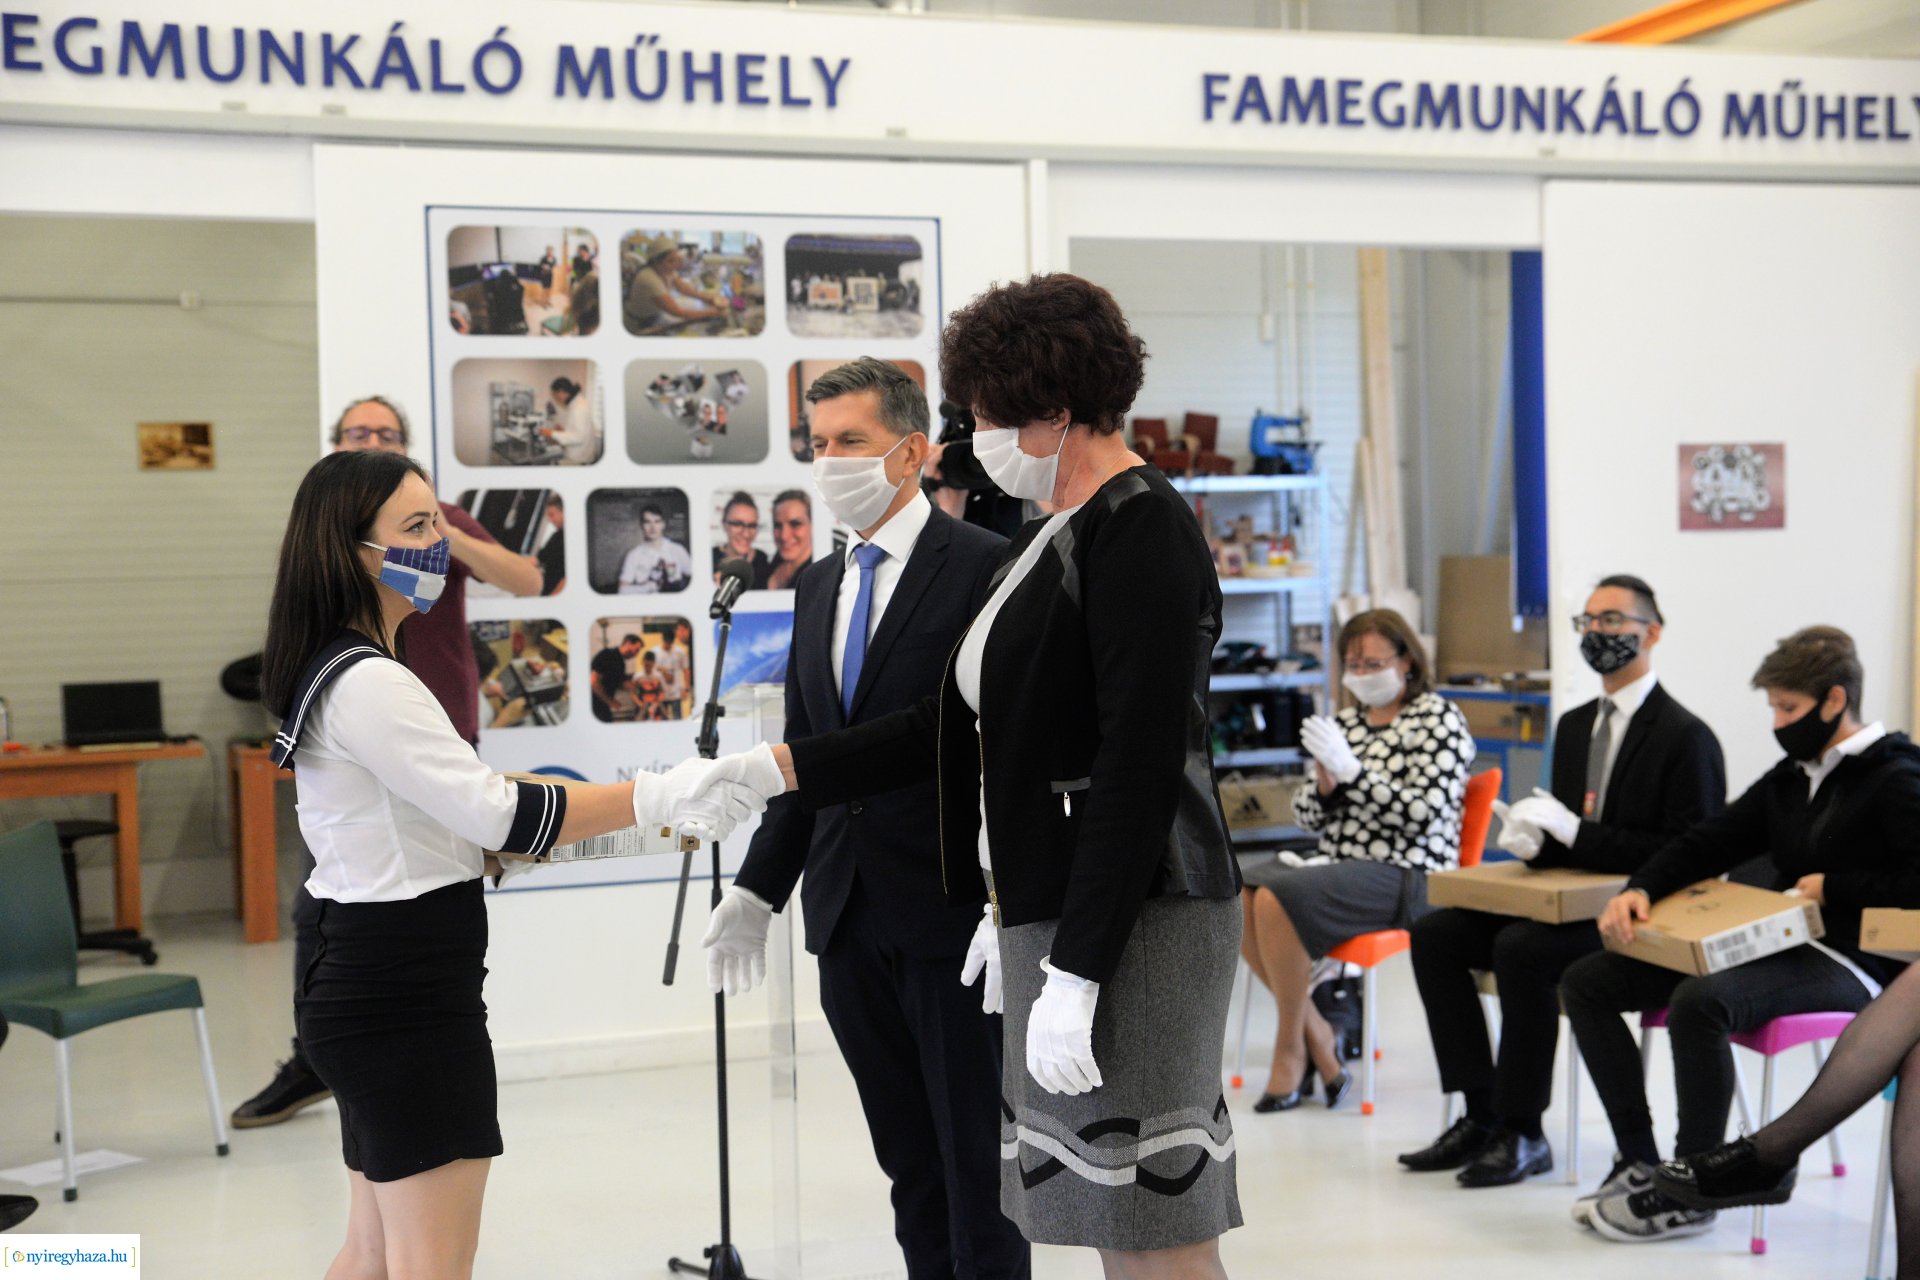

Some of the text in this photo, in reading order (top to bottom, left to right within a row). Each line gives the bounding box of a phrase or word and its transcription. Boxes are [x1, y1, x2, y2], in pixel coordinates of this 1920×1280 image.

[2, 13, 850, 108] EGMUNKÁLÓ MŰHELY
[1202, 73, 1920, 141] FAMEGMUNKÁLÓ MŰHEL
